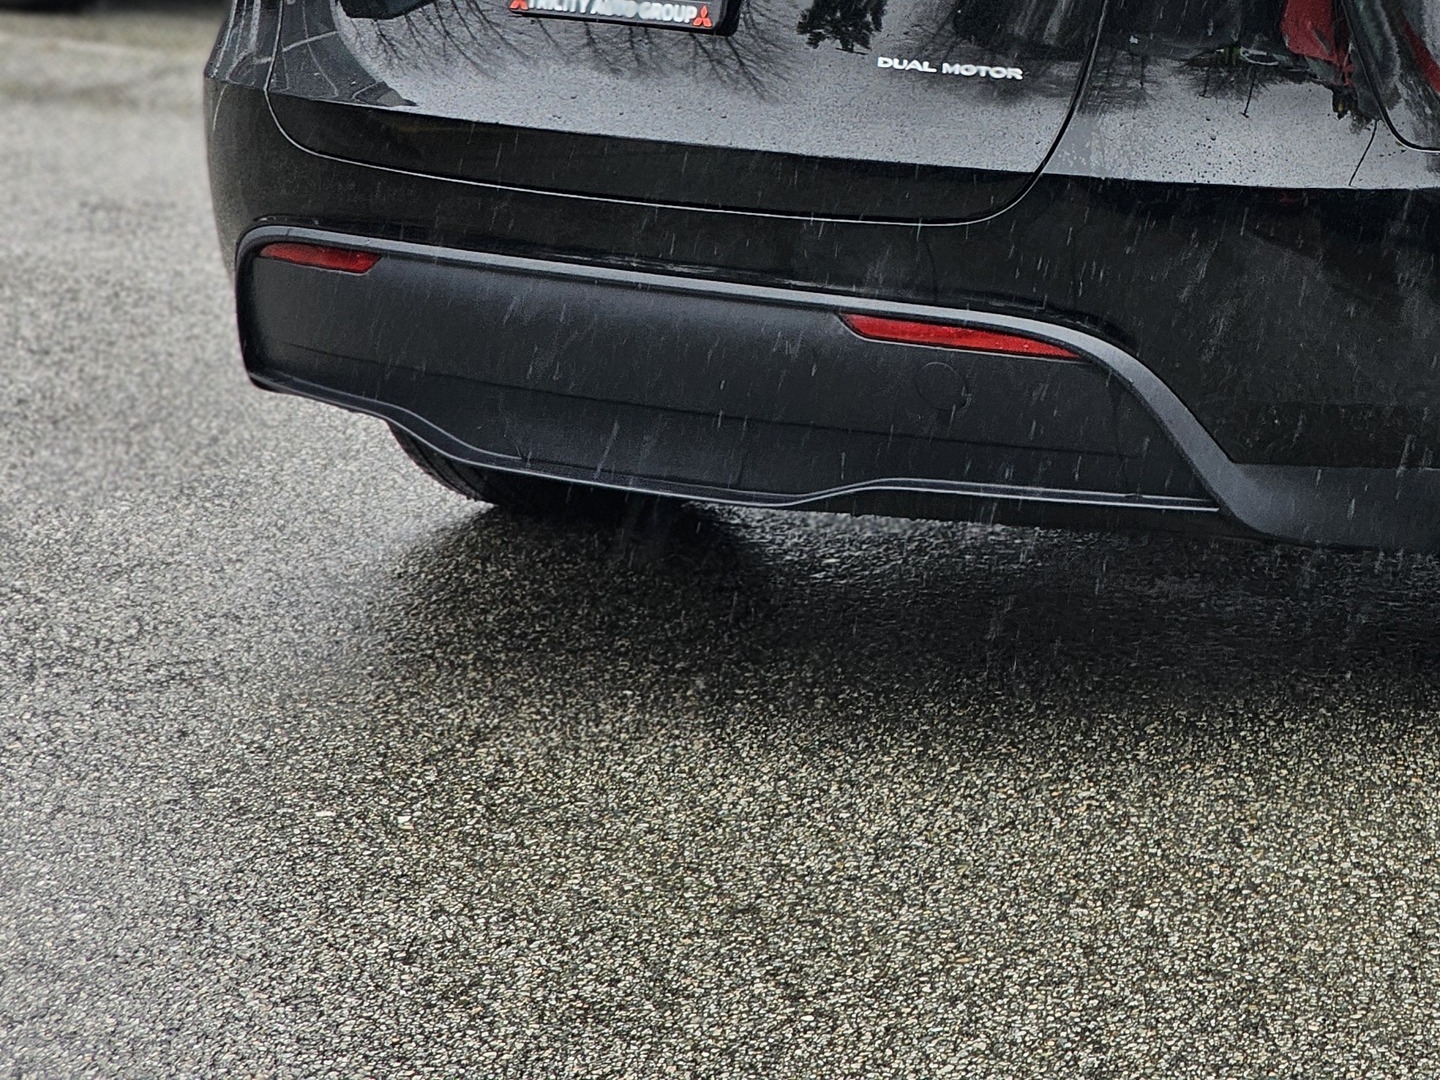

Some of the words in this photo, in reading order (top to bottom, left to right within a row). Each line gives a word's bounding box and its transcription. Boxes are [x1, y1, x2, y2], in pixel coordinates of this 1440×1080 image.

[638, 1, 698, 23] GROUP
[877, 56, 937, 72] DUAL
[942, 63, 1023, 79] MOTOR
